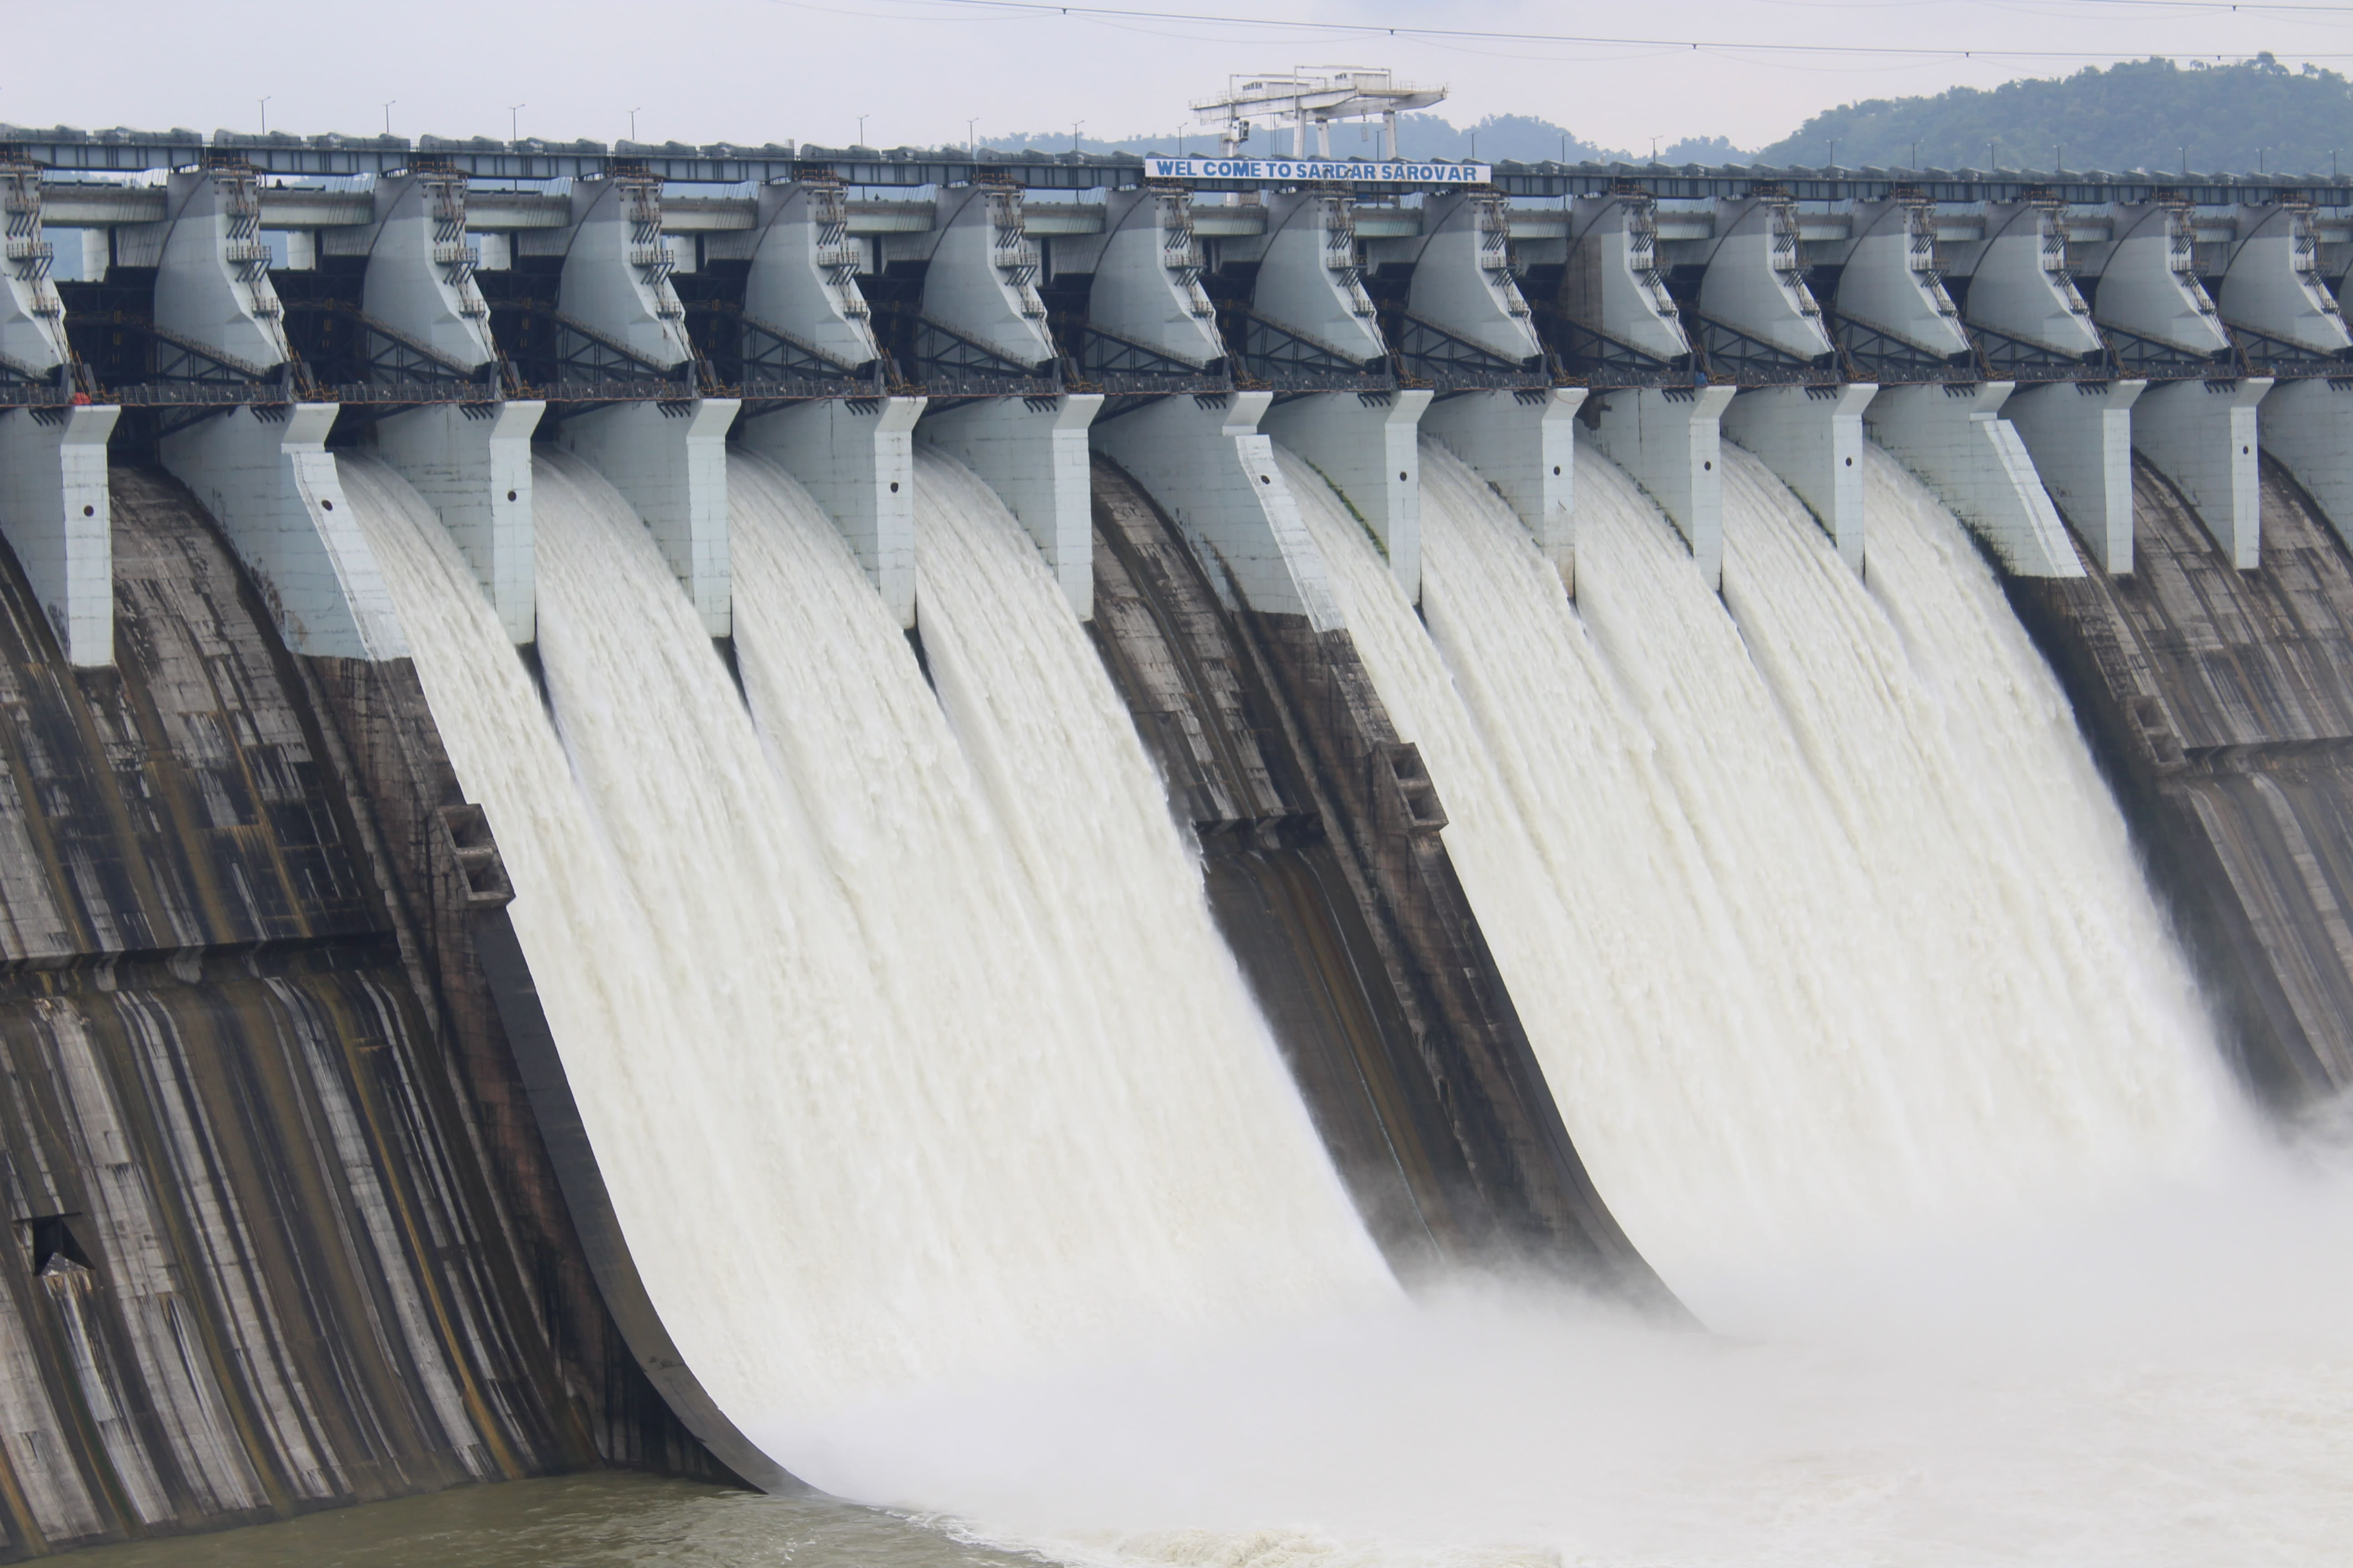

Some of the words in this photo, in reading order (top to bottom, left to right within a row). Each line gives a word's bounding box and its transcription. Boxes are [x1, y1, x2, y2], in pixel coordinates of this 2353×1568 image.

[1266, 163, 1291, 177] TO
[1297, 164, 1375, 179] SARDAR
[1382, 166, 1475, 180] SAROVAR
